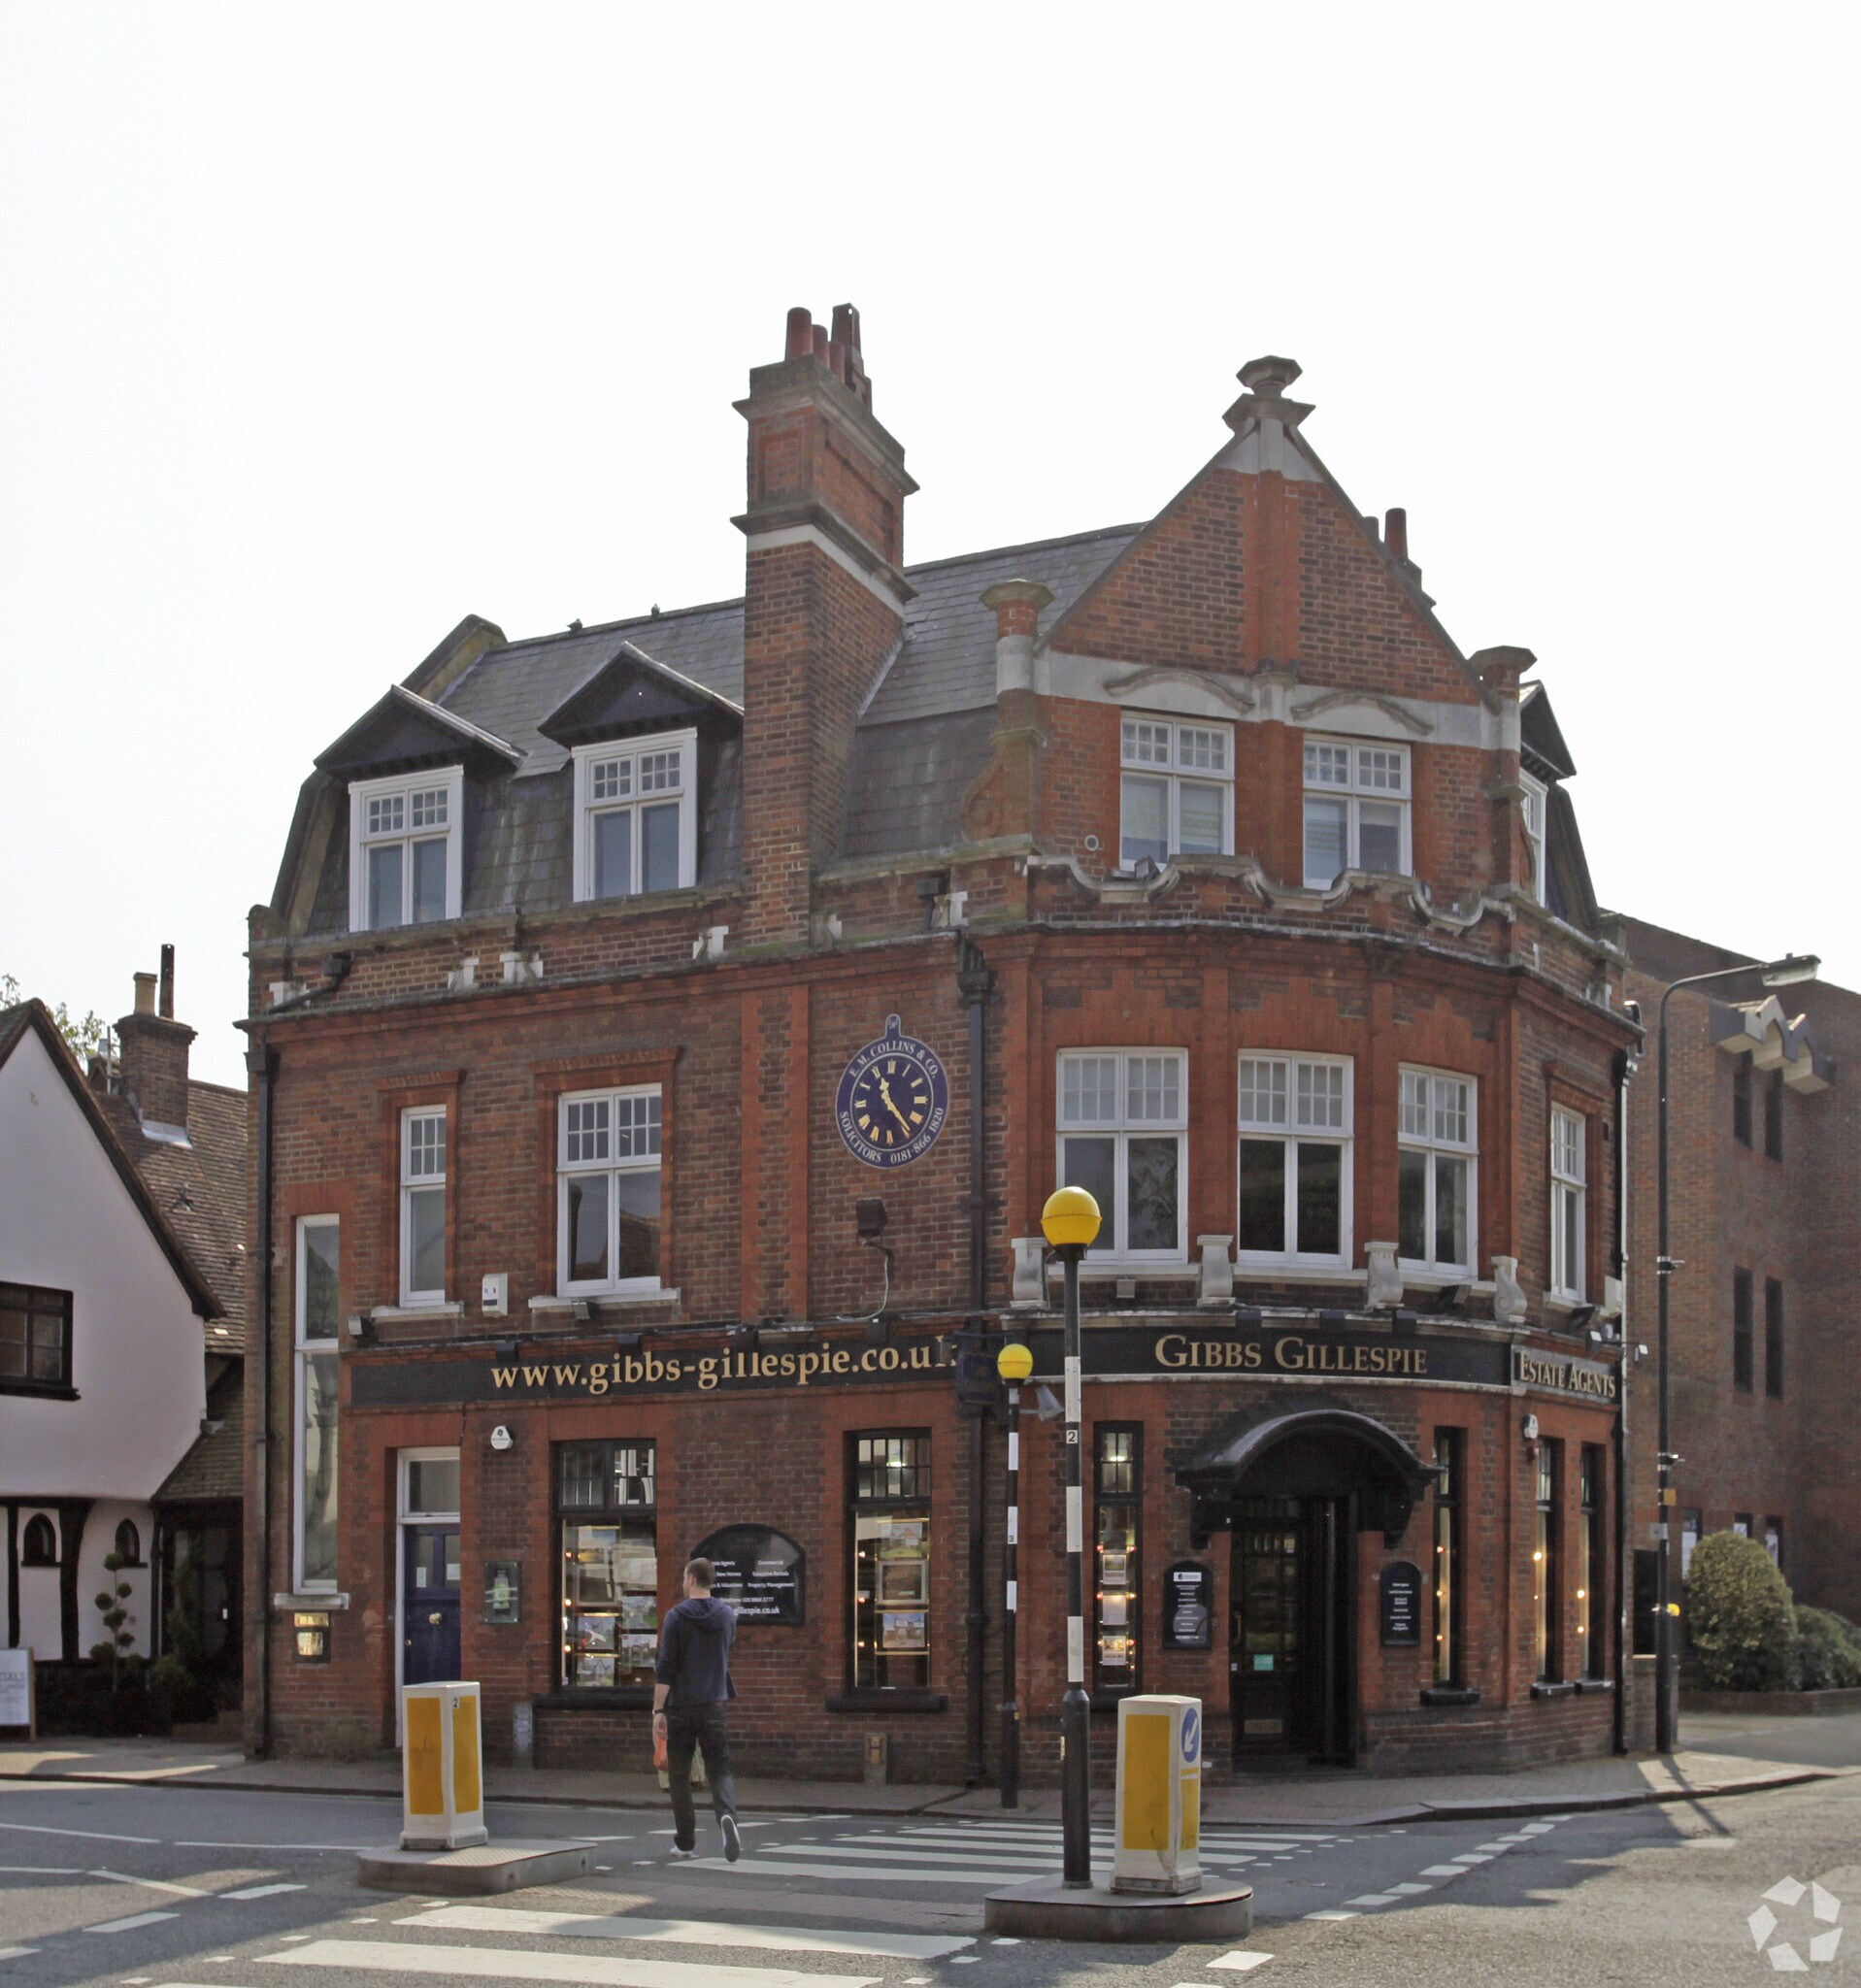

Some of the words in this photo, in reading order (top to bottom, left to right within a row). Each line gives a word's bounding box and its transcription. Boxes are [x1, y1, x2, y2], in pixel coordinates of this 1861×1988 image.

[870, 1041, 915, 1057] COLLINS
[916, 1049, 926, 1060] &
[925, 1059, 939, 1078] CO.
[840, 1110, 882, 1163] SOLICITORS
[928, 1108, 944, 1133] 1820
[1154, 1334, 1261, 1368] GIBBS
[1274, 1336, 1427, 1375] GILLESPIE
[1519, 1350, 1565, 1388] ESTATE
[1569, 1361, 1615, 1398] AGENTS
[1068, 1431, 1076, 1442] 2
[734, 1606, 780, 1616] gillespie.co.uk
